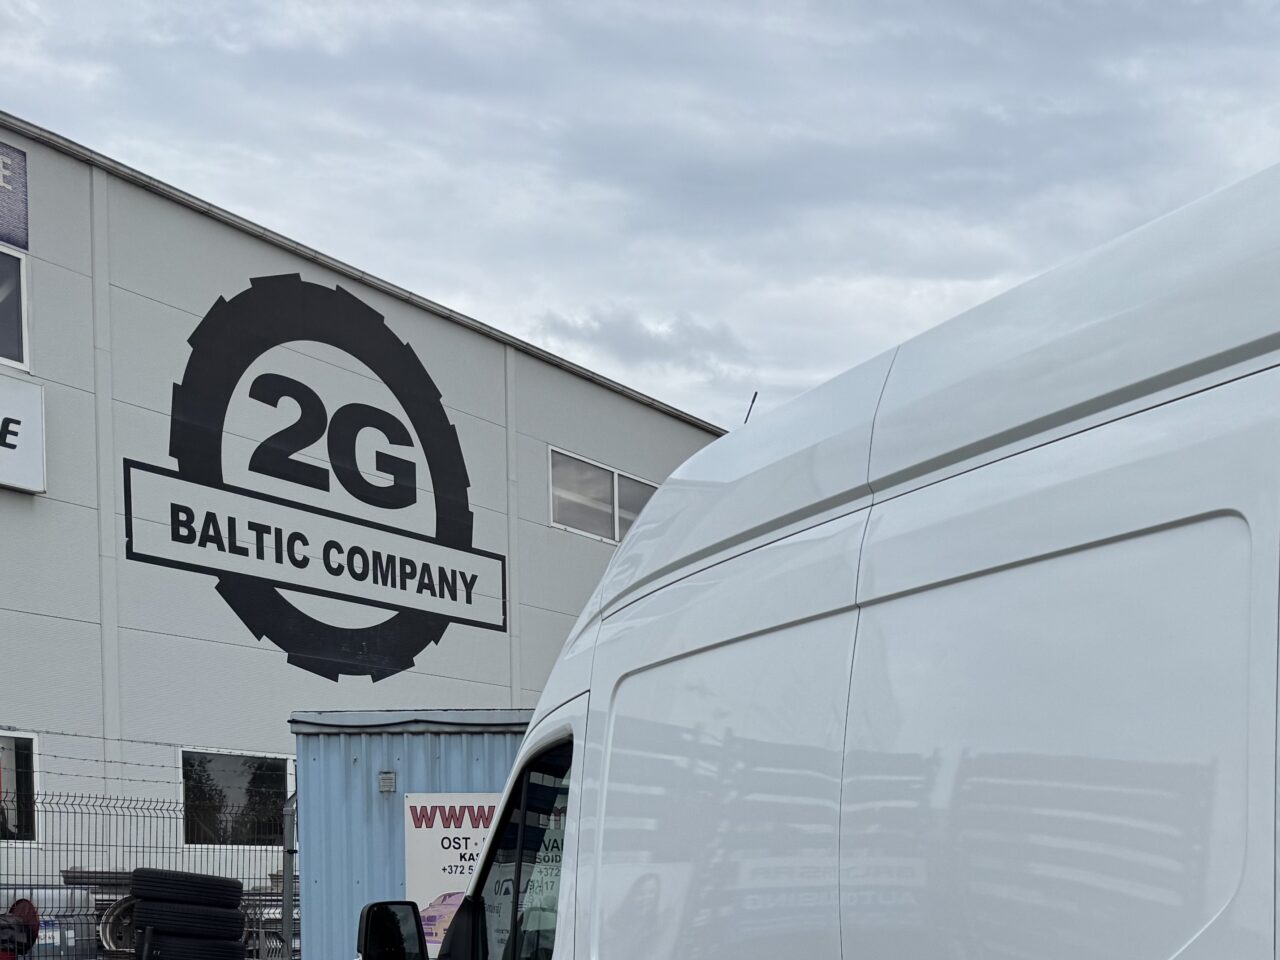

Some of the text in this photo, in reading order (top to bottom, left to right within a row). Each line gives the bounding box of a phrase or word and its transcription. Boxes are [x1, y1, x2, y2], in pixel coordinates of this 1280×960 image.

[0, 416, 21, 450] E
[248, 372, 417, 510] 2G
[170, 502, 478, 605] BALTIC COMPANY
[441, 836, 471, 850] OST
[441, 865, 465, 875] +372
